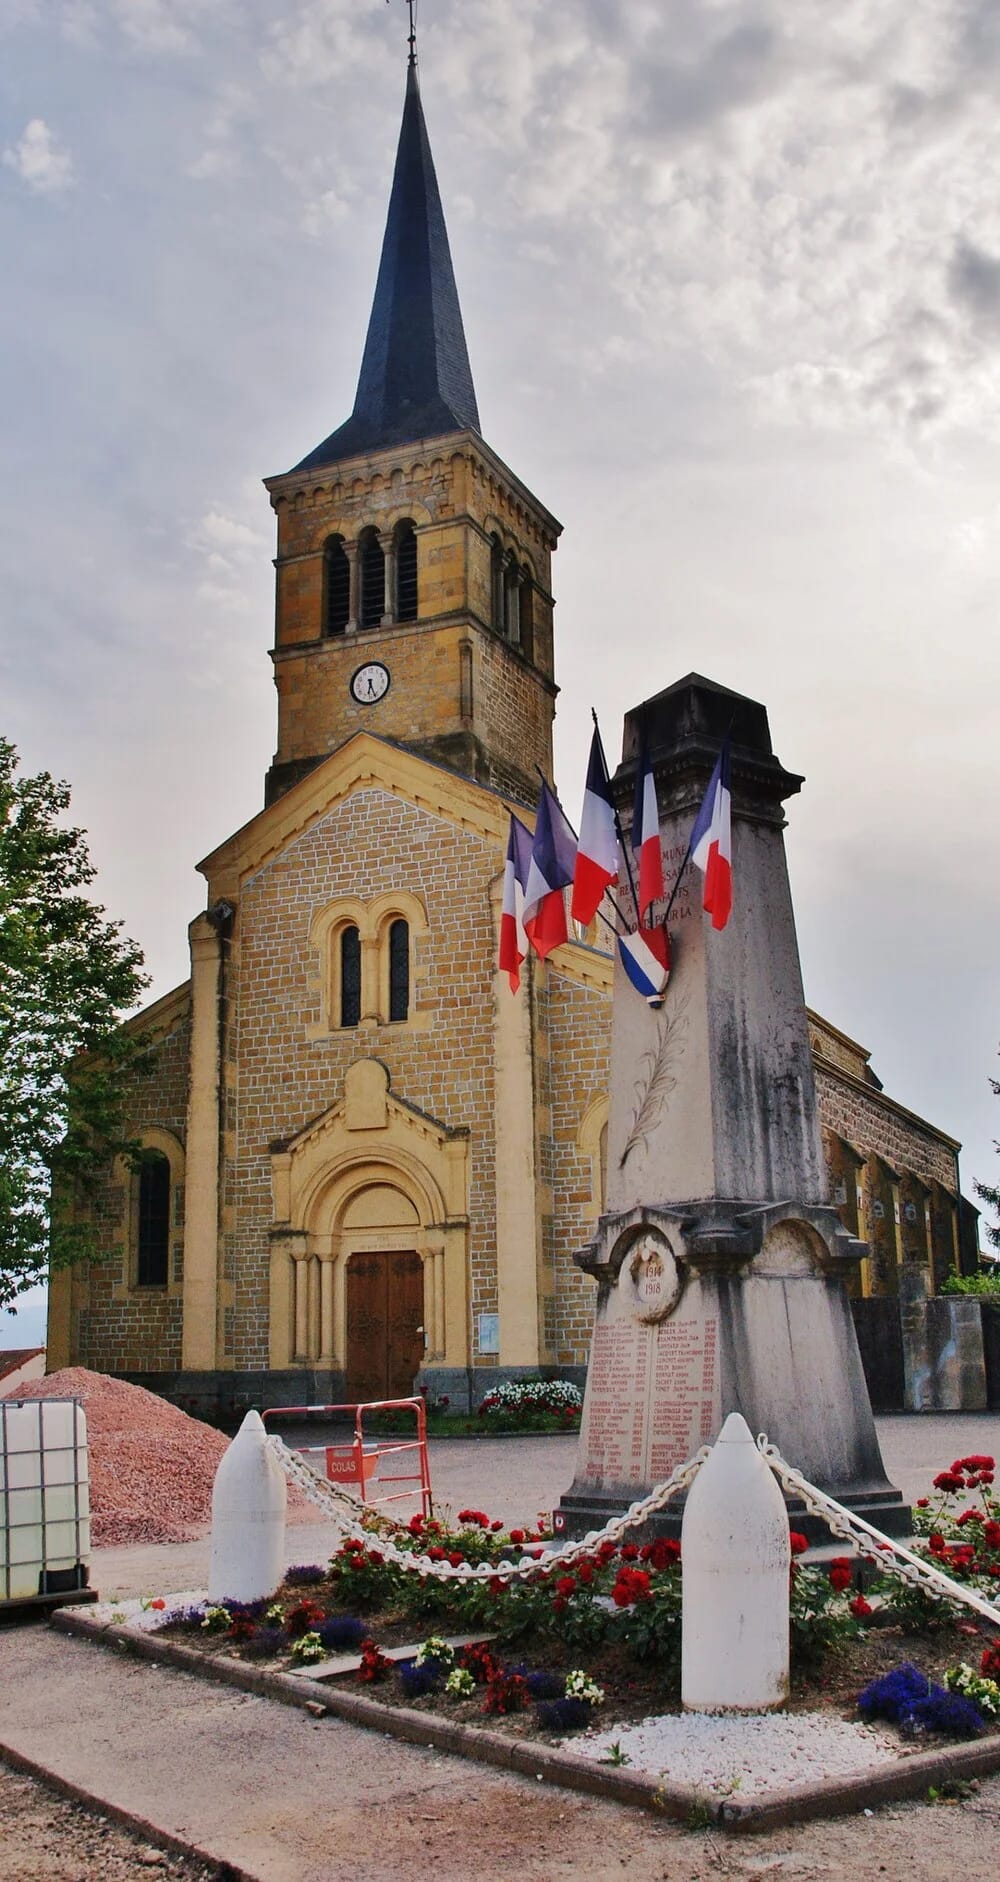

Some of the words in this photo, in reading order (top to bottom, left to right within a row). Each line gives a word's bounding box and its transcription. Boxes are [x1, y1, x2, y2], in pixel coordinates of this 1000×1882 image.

[645, 1266, 662, 1279] 1914
[645, 1283, 661, 1295] 1918
[331, 1461, 356, 1473] COLAS
